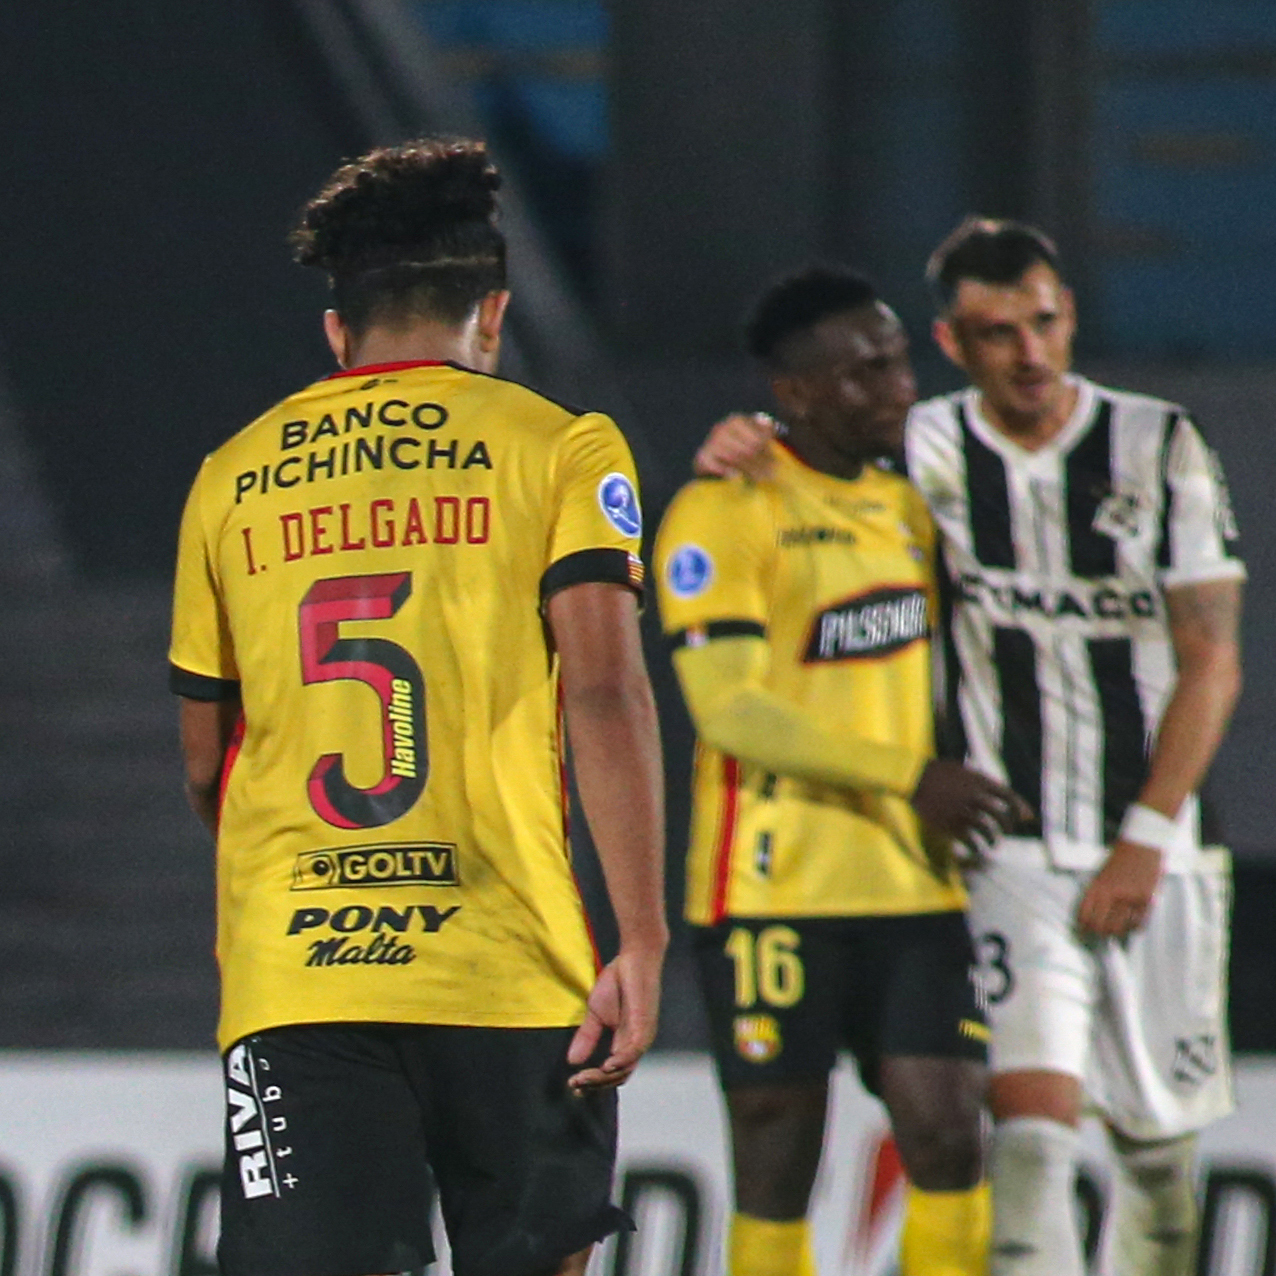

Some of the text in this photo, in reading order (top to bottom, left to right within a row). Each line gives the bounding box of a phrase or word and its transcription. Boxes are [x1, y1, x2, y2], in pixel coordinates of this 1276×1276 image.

[280, 399, 449, 451] BANCO
[235, 435, 493, 504] PICHINCHA
[242, 496, 491, 575] I. DELGADO
[297, 571, 430, 830] 5
[389, 678, 417, 778] Havoline
[343, 852, 447, 880] GOLTV
[287, 904, 462, 936] PONY
[305, 932, 417, 967] Malta
[724, 925, 805, 1009] 16
